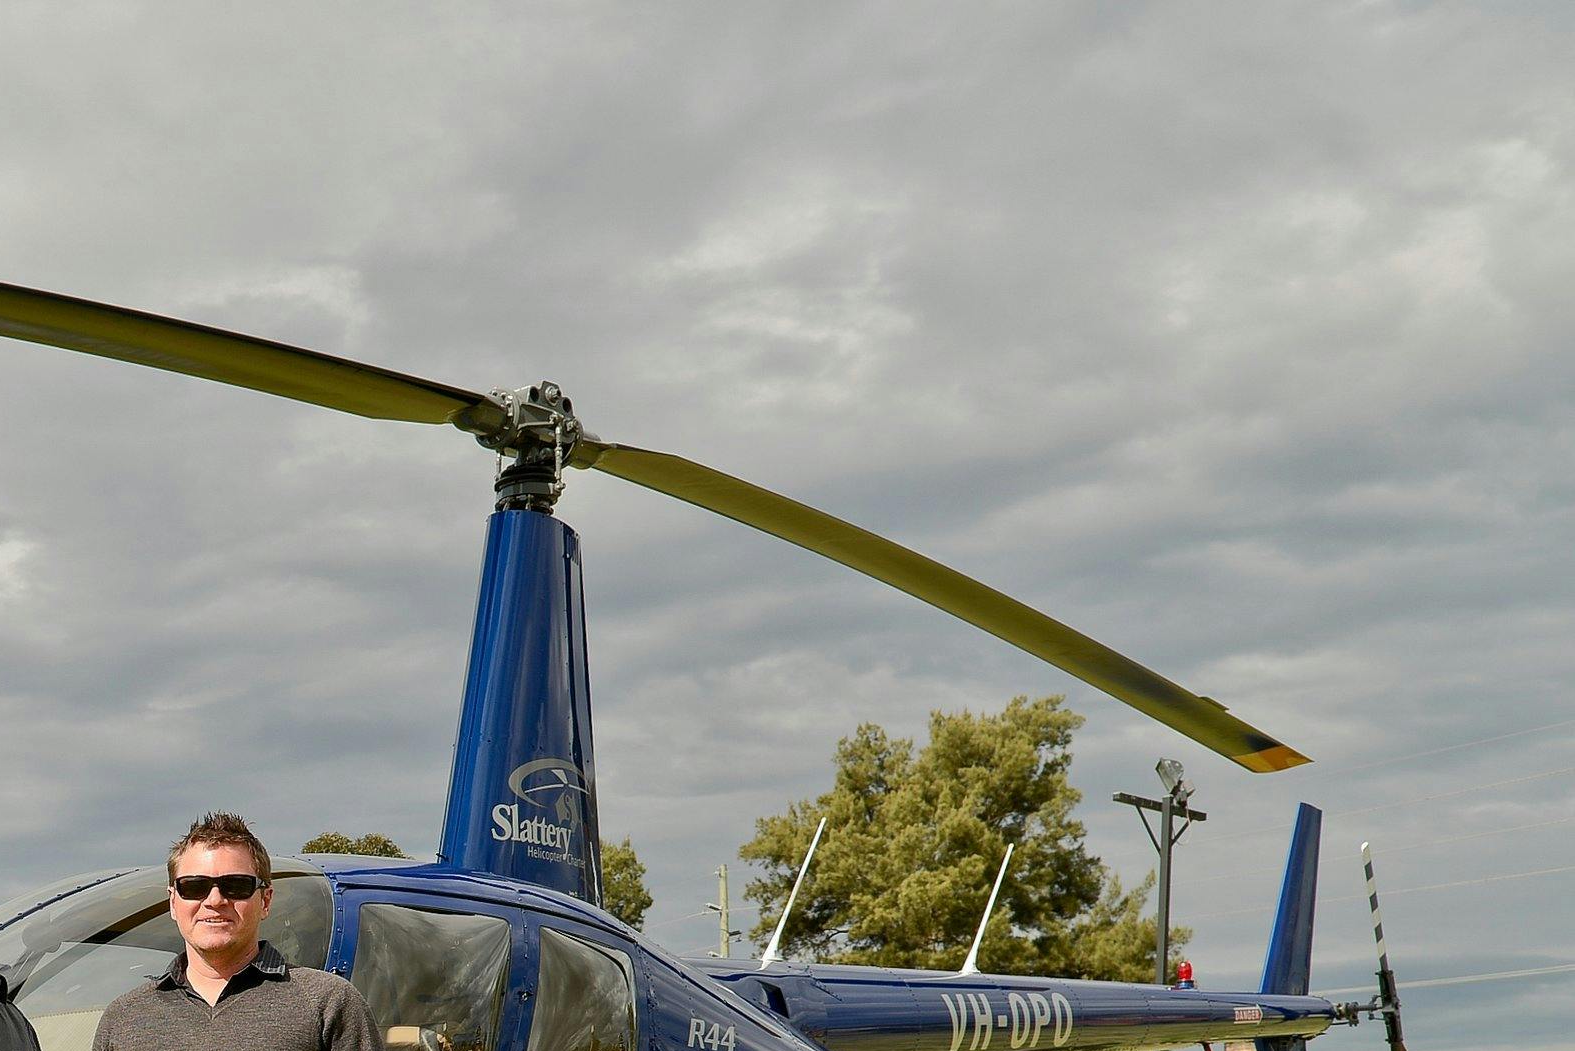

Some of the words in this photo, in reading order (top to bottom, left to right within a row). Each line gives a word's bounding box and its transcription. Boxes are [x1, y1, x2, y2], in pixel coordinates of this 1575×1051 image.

[491, 804, 572, 861] Slattery
[527, 845, 562, 863] Helicopter
[1234, 1010, 1260, 1021] DANGER
